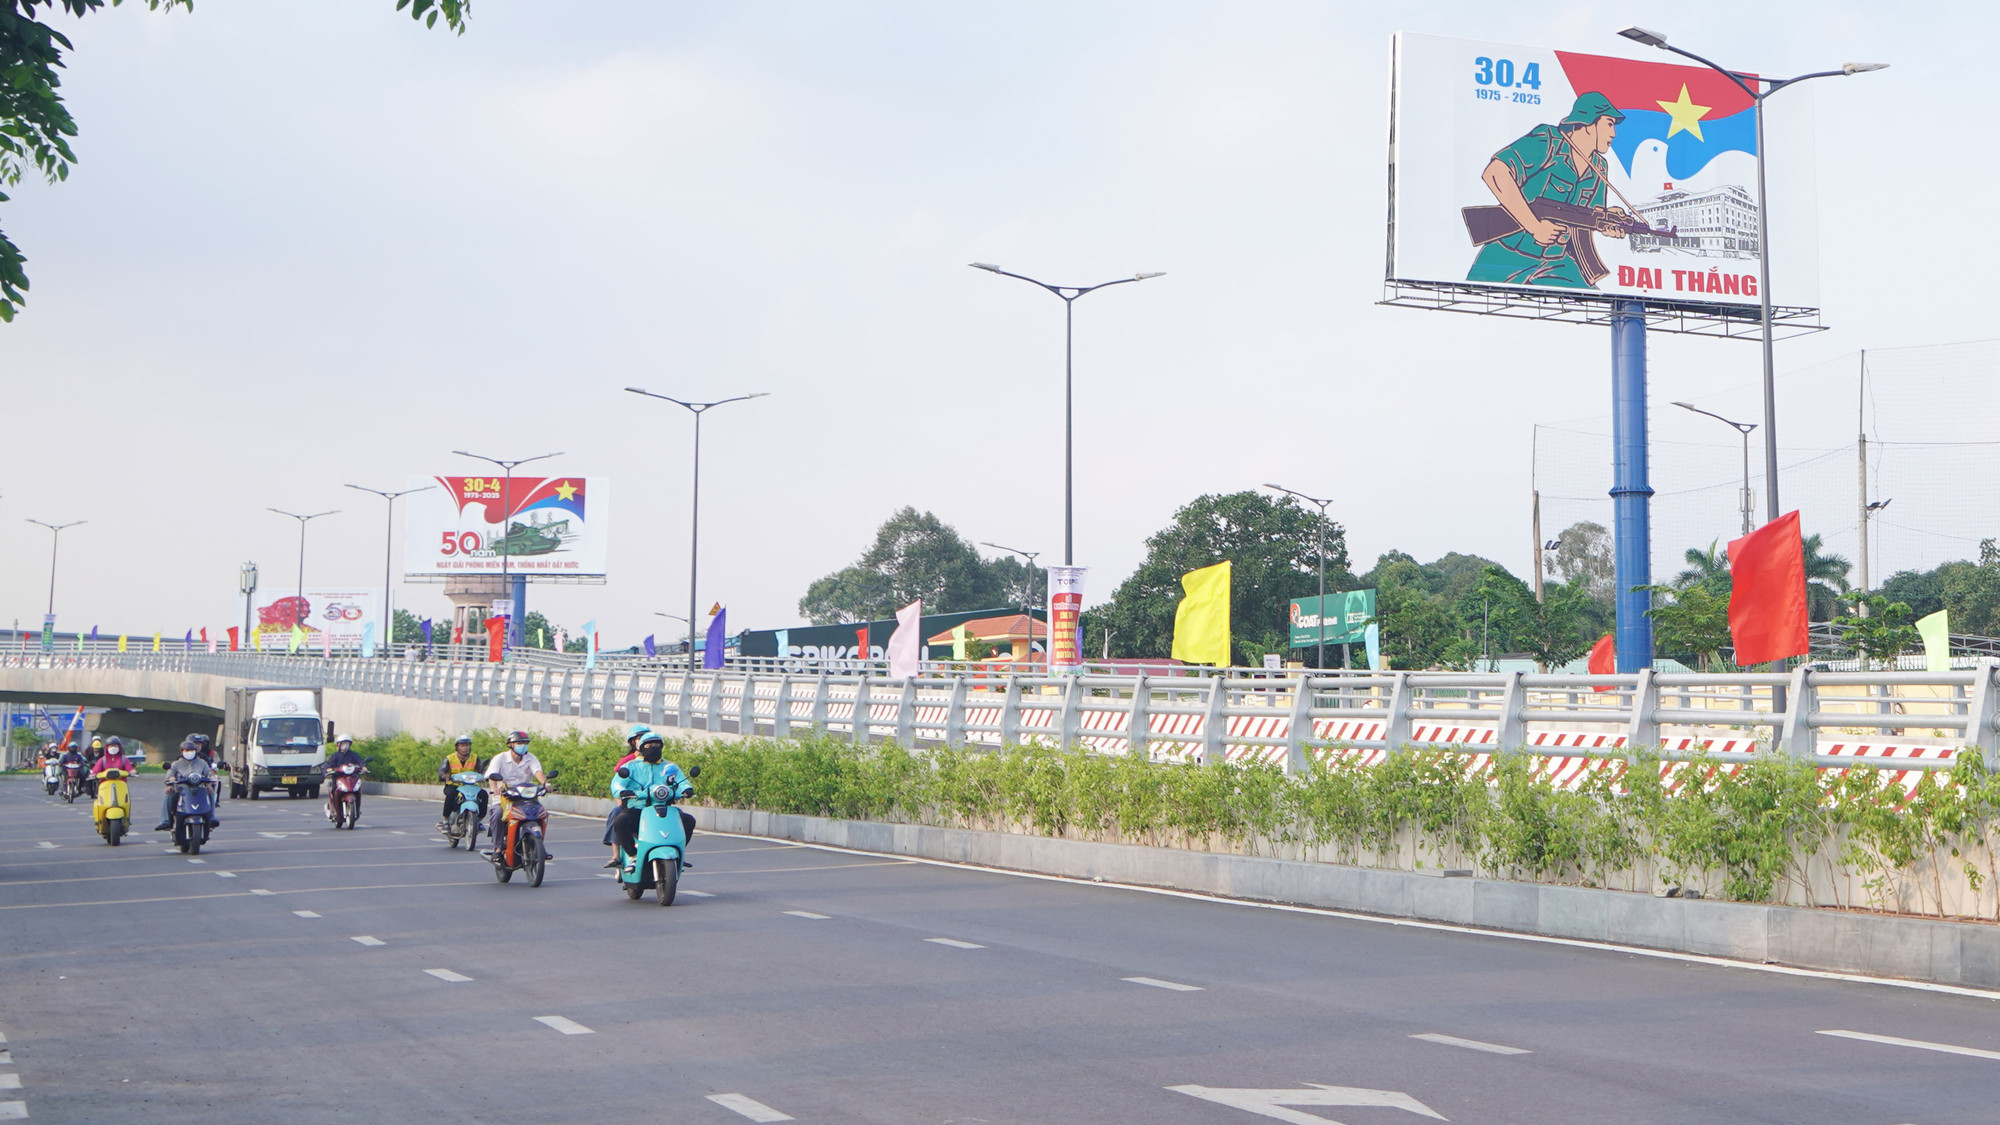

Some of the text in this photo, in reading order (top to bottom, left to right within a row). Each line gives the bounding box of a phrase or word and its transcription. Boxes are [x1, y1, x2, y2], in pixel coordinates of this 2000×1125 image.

[1474, 56, 1542, 90] 30.4
[1475, 88, 1501, 101] 1975
[1512, 91, 1542, 105] 2025
[1617, 264, 1758, 297] ĐẠI THẮNG
[463, 478, 501, 492] 30-4
[440, 530, 481, 556] 50
